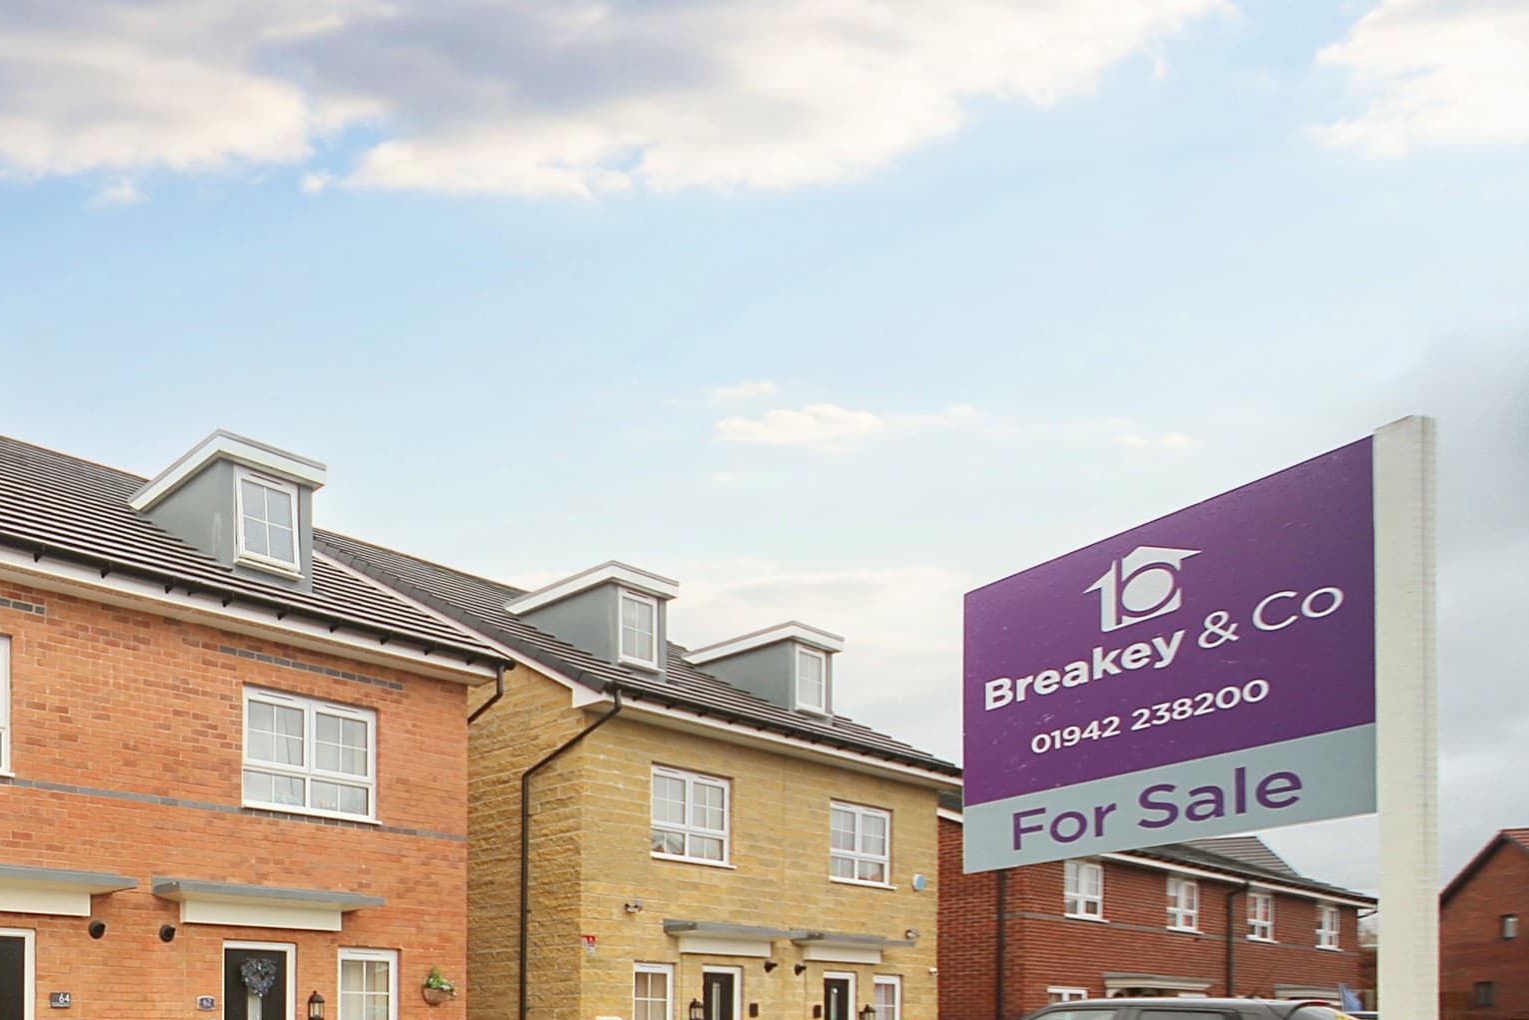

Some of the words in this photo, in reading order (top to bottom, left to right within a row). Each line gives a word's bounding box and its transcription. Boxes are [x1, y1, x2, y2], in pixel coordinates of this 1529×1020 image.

[984, 629, 1185, 711] Breakey
[1198, 610, 1239, 649] &
[1252, 586, 1344, 632] Co
[1031, 716, 1121, 754] 01942
[1131, 679, 1270, 731] 238200
[1012, 800, 1117, 851] For
[1137, 766, 1303, 829] Sale
[58, 993, 70, 1004] 64
